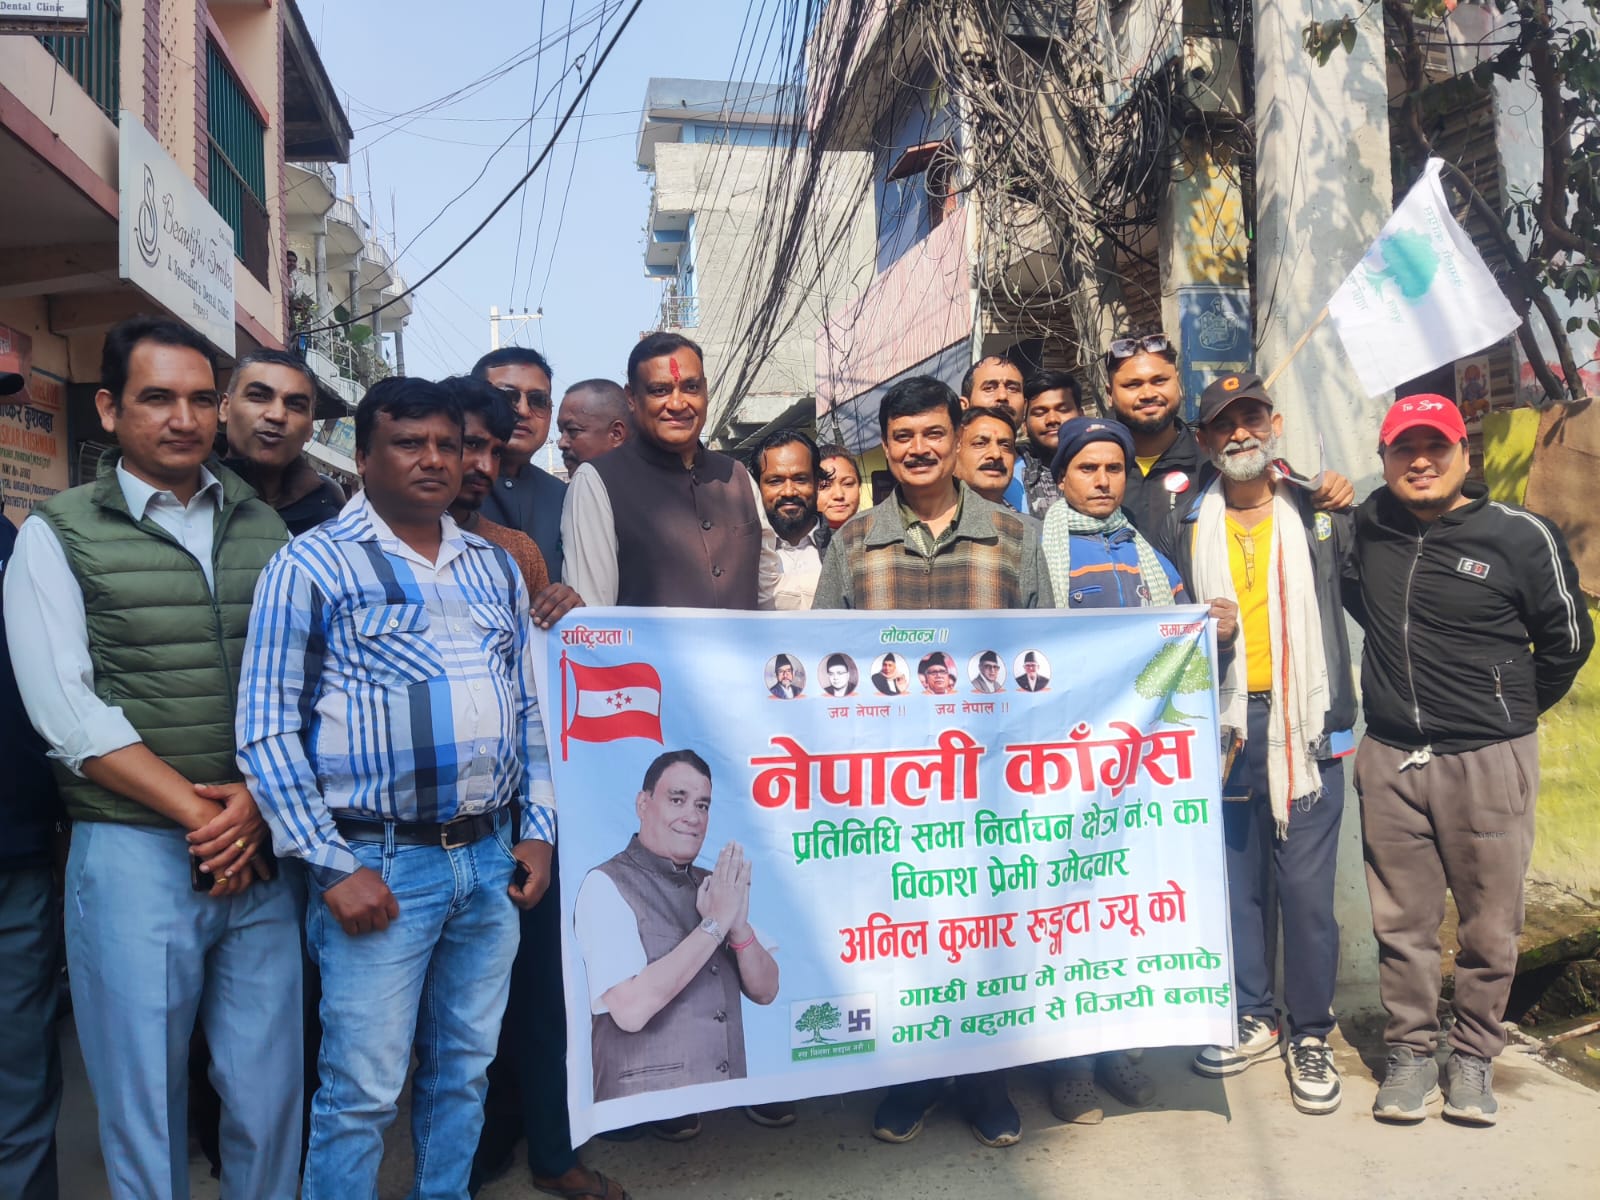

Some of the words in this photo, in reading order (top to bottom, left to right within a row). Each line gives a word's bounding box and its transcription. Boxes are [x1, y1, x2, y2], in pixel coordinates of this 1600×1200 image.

[0, 1, 31, 11] Dental
[36, 3, 64, 12] Clinic
[162, 192, 206, 268] Beautiful
[202, 284, 217, 310] Dental
[561, 624, 623, 649] राष्ट्रियता
[880, 626, 935, 644] लोकतन्त्र
[827, 706, 851, 719] जय
[855, 703, 892, 718] नेपाल
[934, 702, 956, 715] जय
[961, 699, 996, 714] नेपाल
[750, 730, 985, 812] नेपाली
[1005, 721, 1195, 797] काँग्रेस
[792, 816, 903, 865] प्रतिनिधि
[911, 820, 965, 853] सभा
[974, 808, 1075, 846] निर्वाचन
[1081, 802, 1119, 840] क्षेत्र
[1173, 798, 1209, 825] का
[891, 861, 978, 901] विकाश
[986, 854, 1039, 898] प्रेमी
[1046, 848, 1131, 888] उमेदवार
[838, 912, 929, 964] अनिल
[938, 911, 1018, 963] कुमार
[1098, 893, 1146, 937] ज्यू
[1148, 879, 1187, 923] को
[976, 974, 1028, 997] छाप
[1063, 957, 1129, 983] मोहर
[1135, 946, 1222, 974] लगाके
[891, 1014, 952, 1044] भारी
[960, 1006, 1036, 1036] बहुमत
[1044, 996, 1067, 1021] से
[1075, 984, 1155, 1016] विजयी
